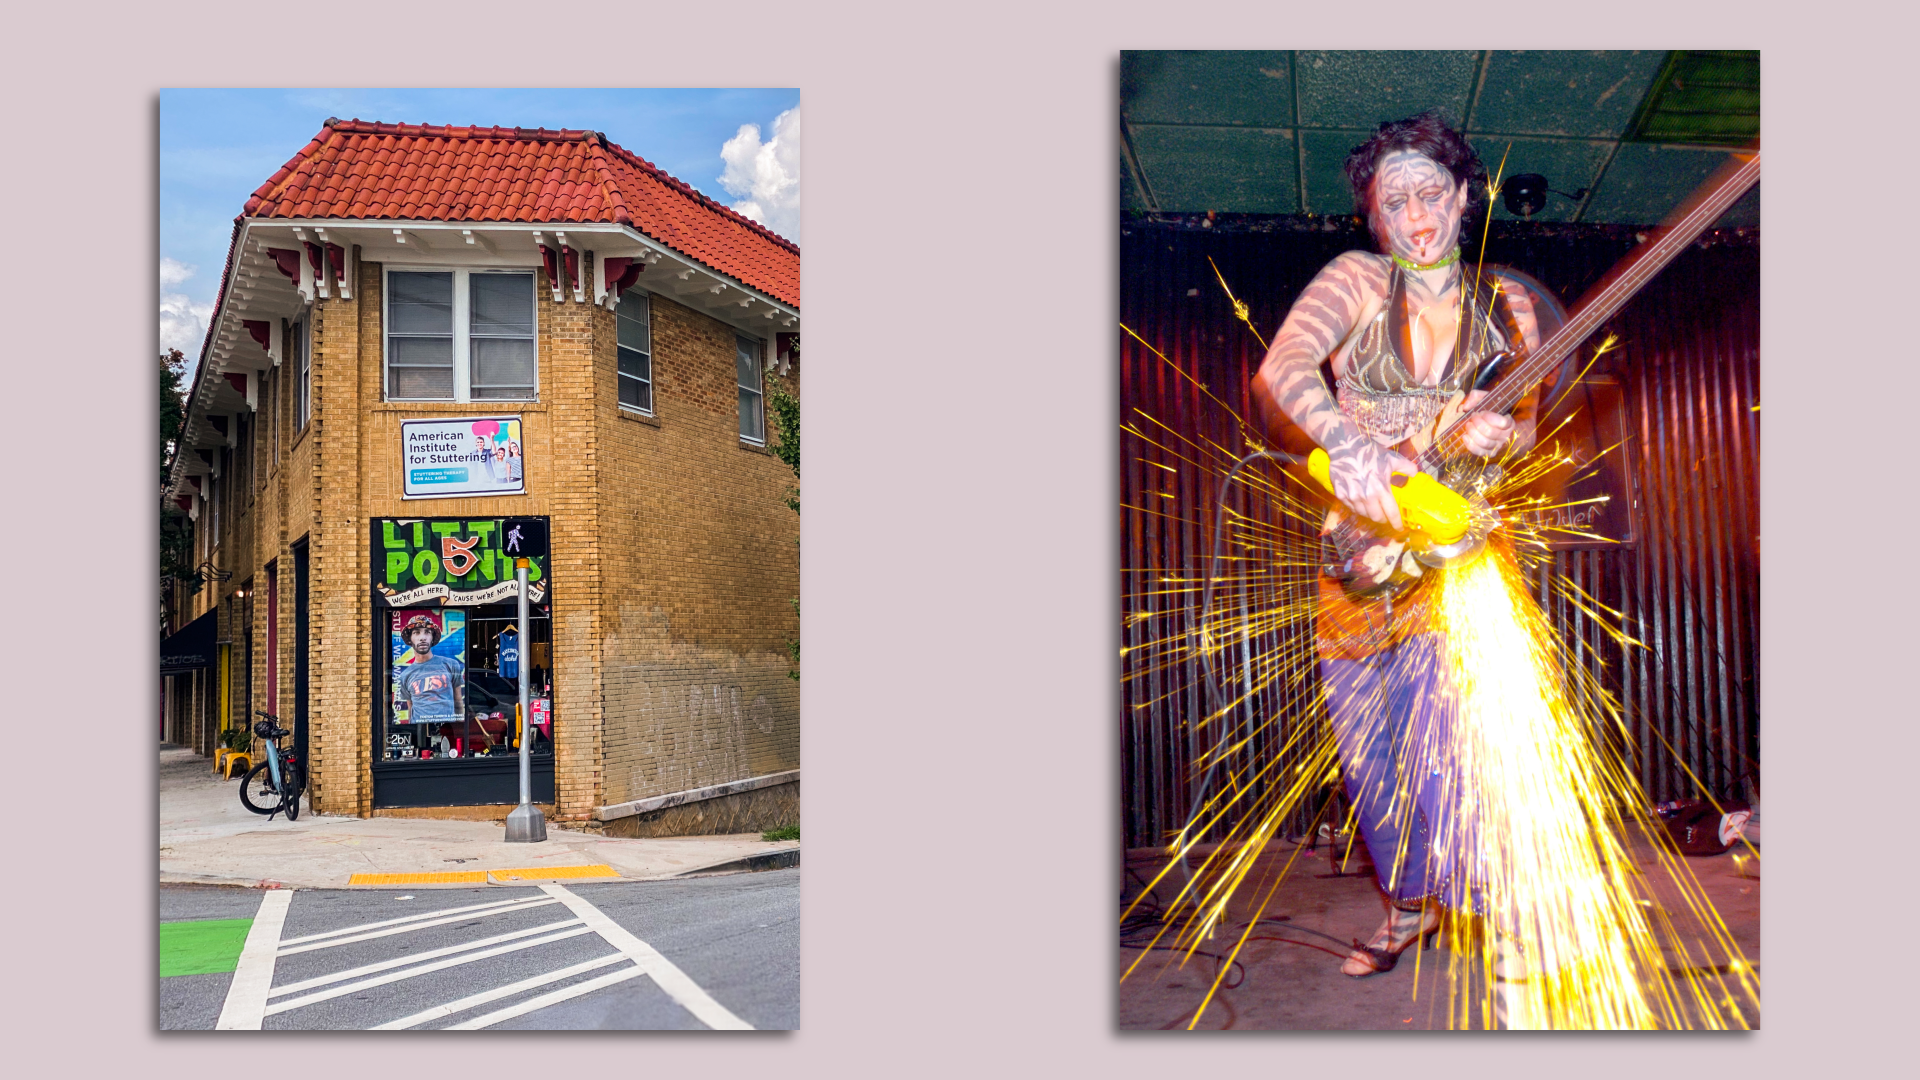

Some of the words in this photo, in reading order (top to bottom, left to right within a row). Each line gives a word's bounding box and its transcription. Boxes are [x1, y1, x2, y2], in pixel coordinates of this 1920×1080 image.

[409, 431, 464, 442] American
[409, 443, 457, 453] Institute
[410, 454, 427, 465] for
[430, 453, 488, 464] Stuttering
[382, 521, 503, 549] LITT
[441, 536, 480, 577] 5
[391, 593, 411, 605] WE'RE
[413, 589, 424, 599] ALL
[427, 586, 444, 594] HERE
[453, 594, 474, 602] 'CAUSE
[476, 591, 494, 600] WE'RE
[497, 585, 509, 596] NOT
[510, 583, 519, 591] AL
[392, 610, 402, 643] STUFF
[393, 645, 402, 660] WE
[411, 673, 447, 695] YES!
[393, 704, 402, 724] SAY
